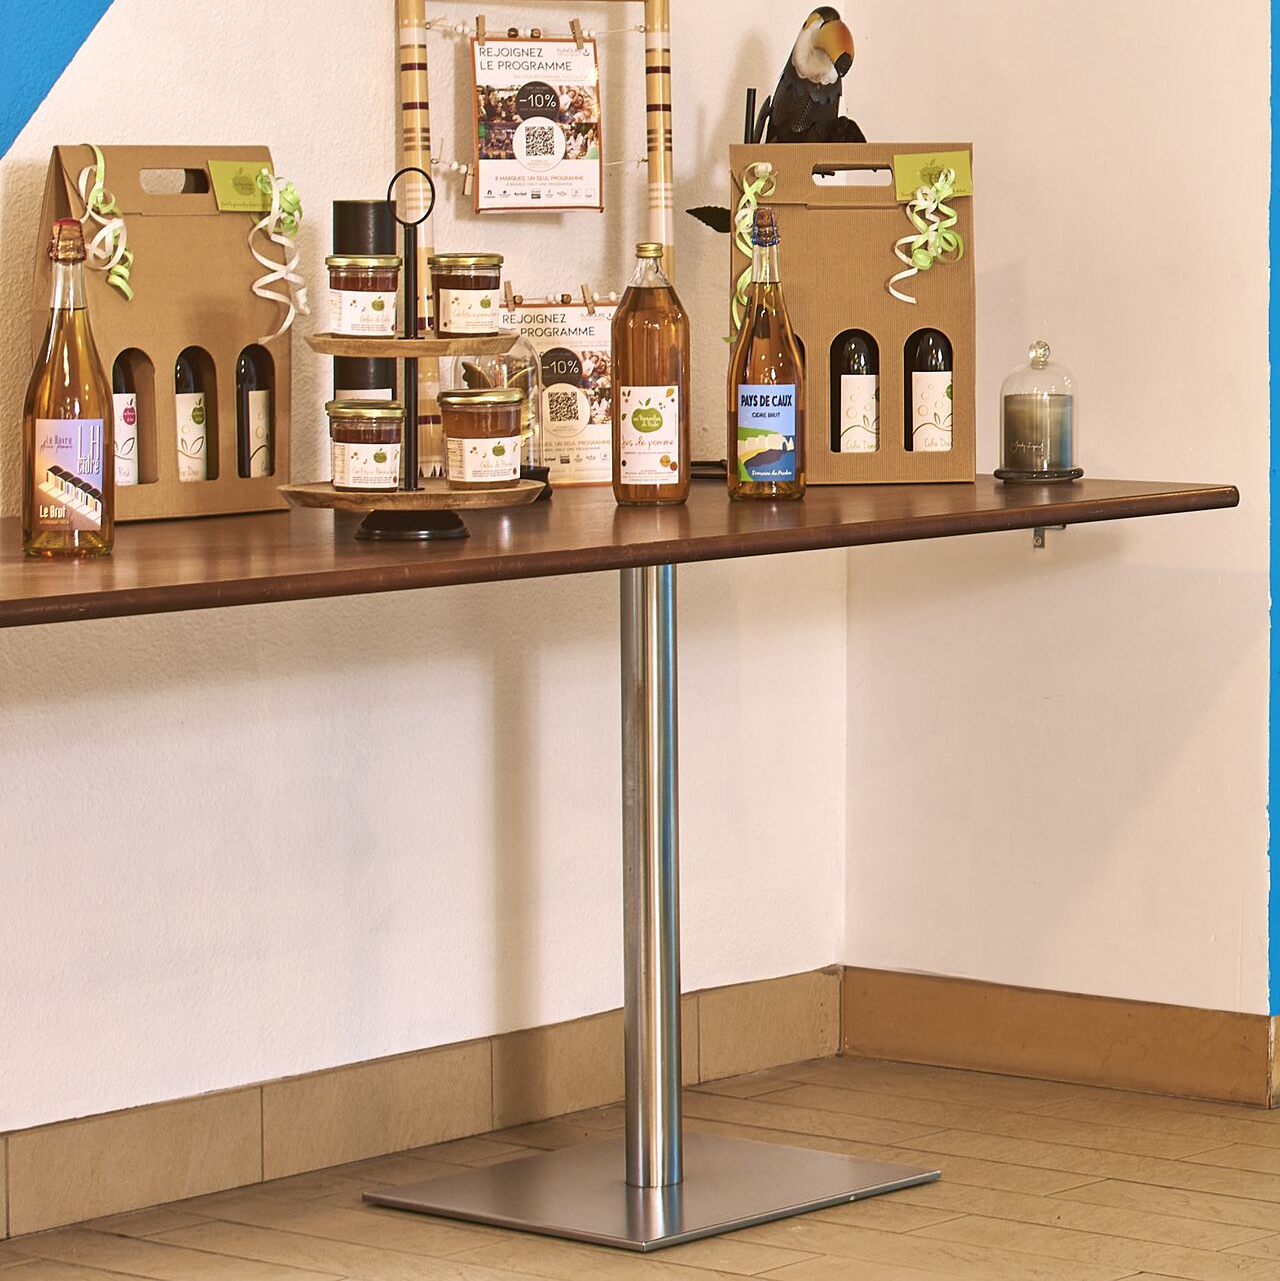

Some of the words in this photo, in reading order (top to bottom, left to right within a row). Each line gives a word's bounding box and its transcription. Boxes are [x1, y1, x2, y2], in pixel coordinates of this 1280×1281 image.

[479, 47, 544, 58] REJOIGNEZ
[480, 60, 494, 71] LE
[497, 60, 572, 71] PROGRAMME
[502, 313, 567, 324] REJOIGNEZ
[521, 325, 595, 337] PROGRAMME
[741, 394, 758, 407] PAYS
[760, 395, 770, 407] DE
[771, 394, 792, 407] CAUX
[40, 505, 48, 518] Le
[50, 505, 66, 518] Brut
